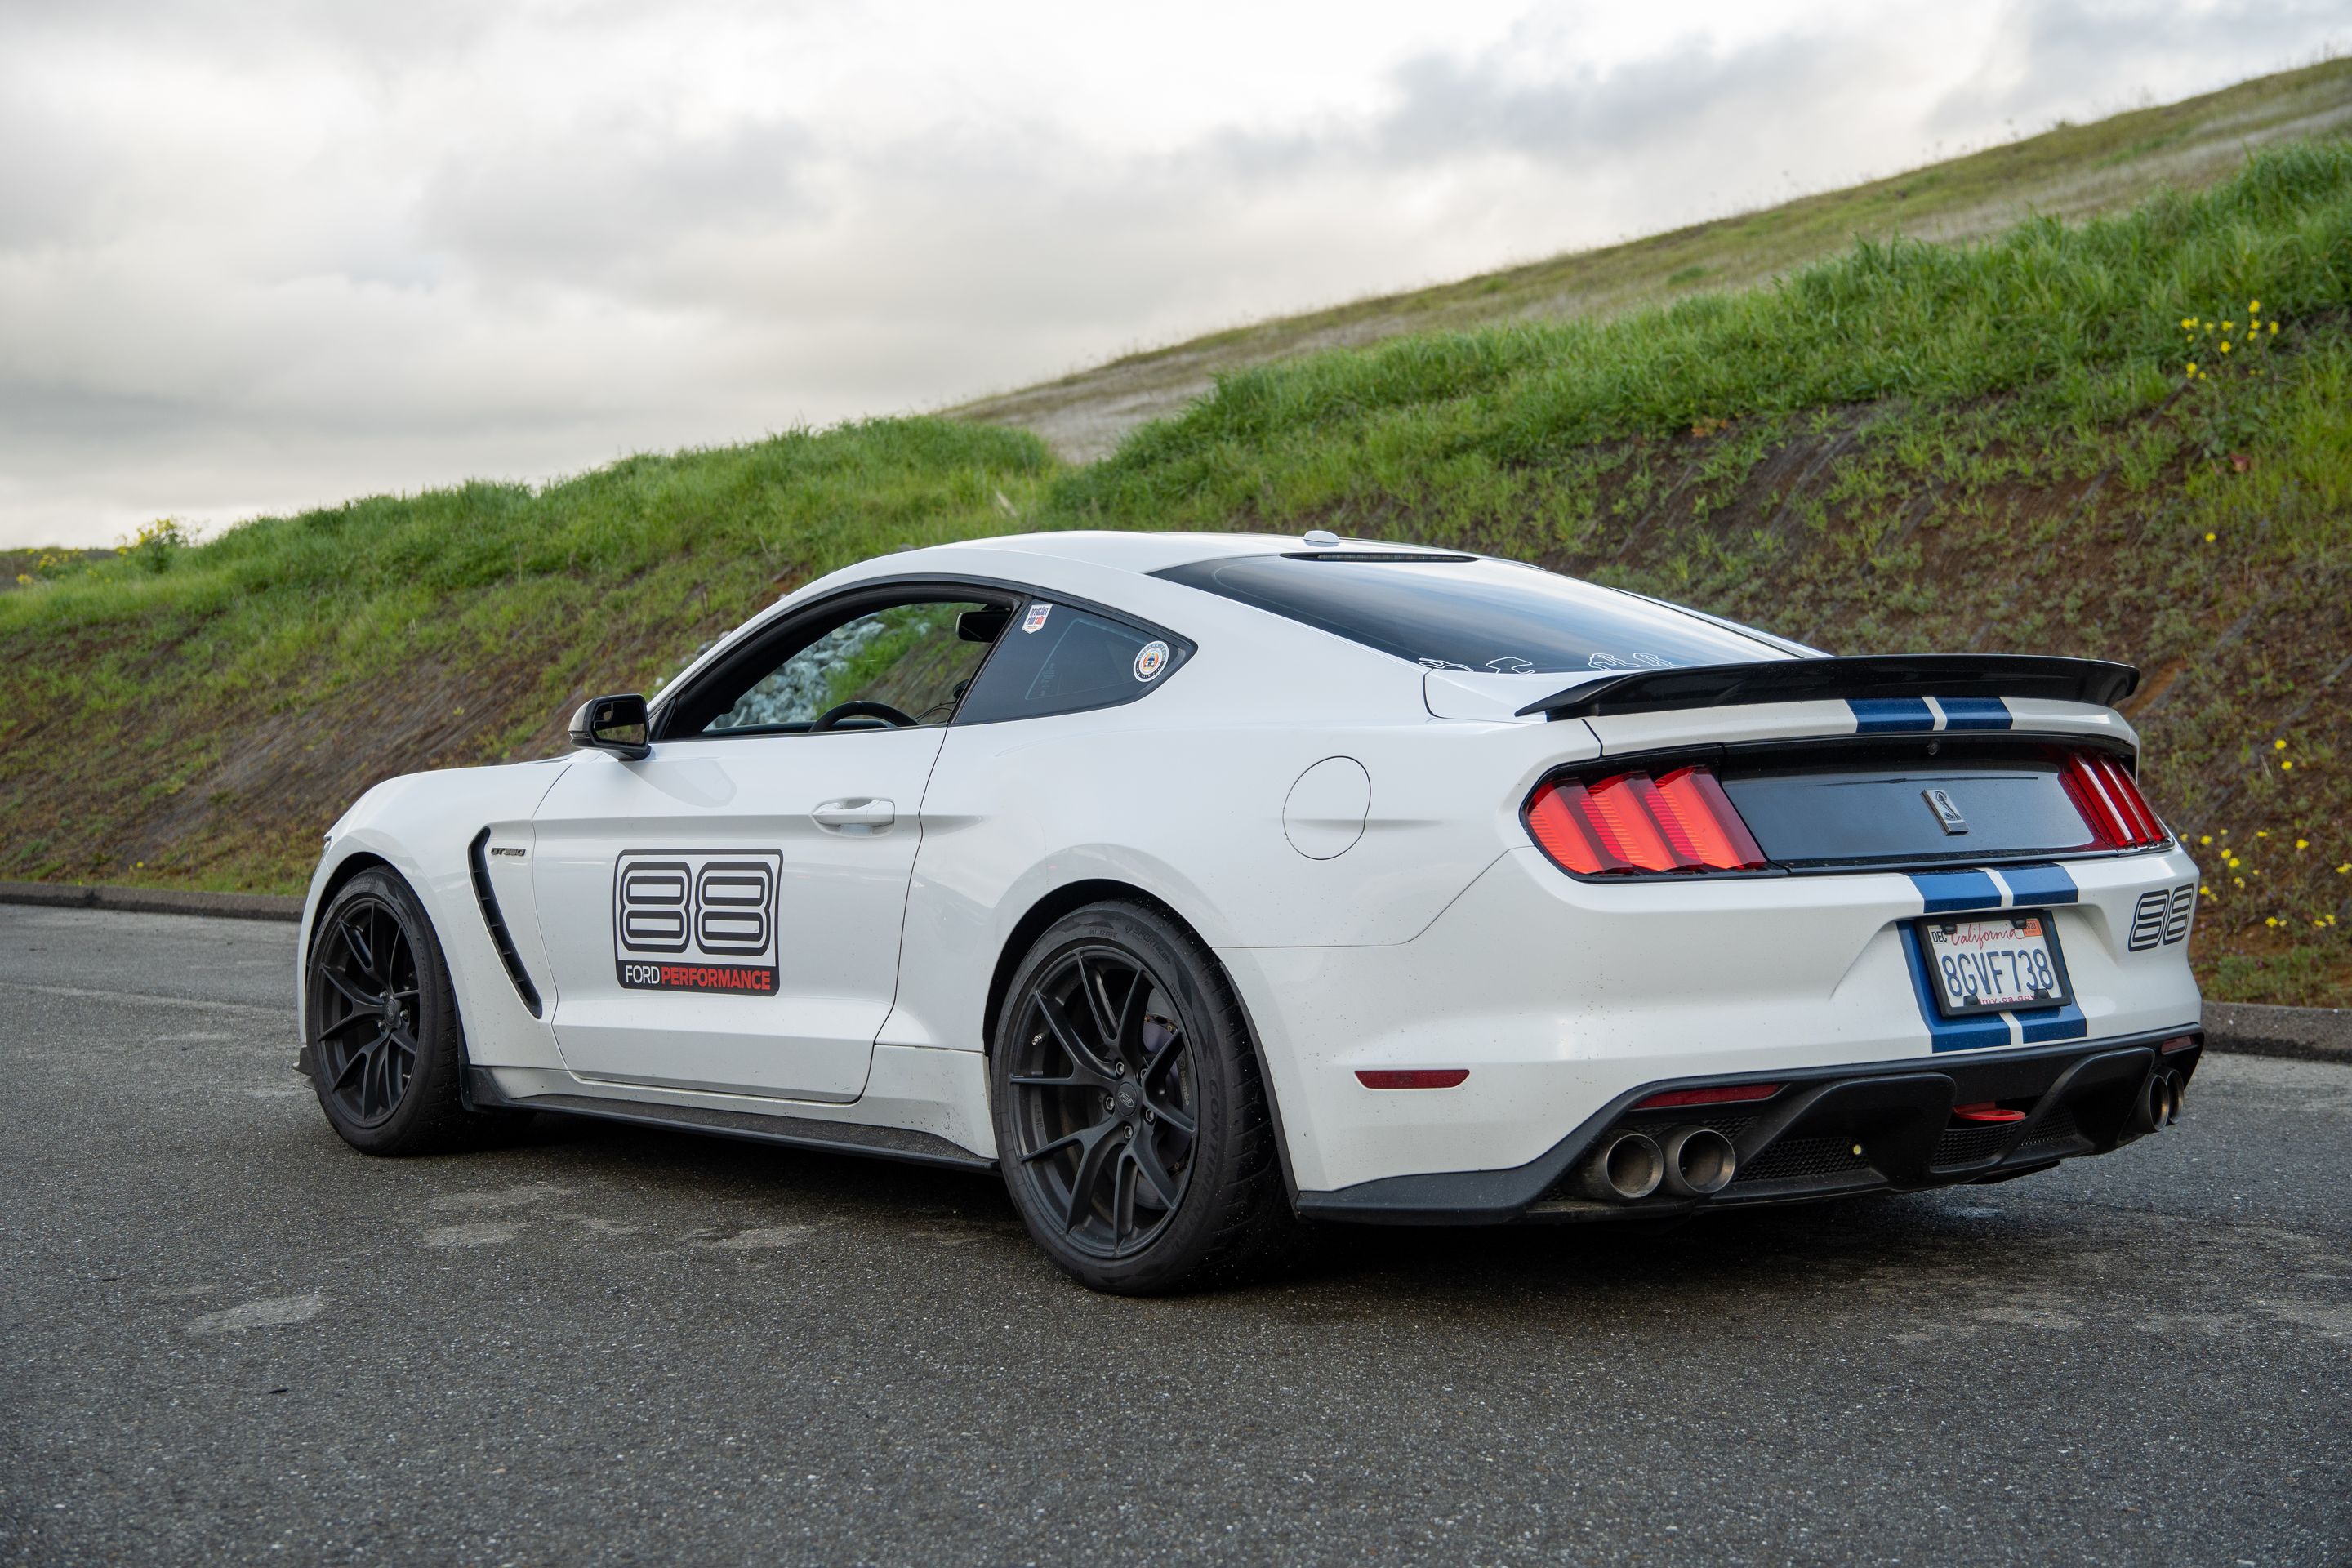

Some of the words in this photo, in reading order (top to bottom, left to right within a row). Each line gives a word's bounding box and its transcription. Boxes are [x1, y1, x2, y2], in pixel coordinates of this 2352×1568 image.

[620, 862, 773, 956] 88
[2128, 883, 2194, 952] 88
[1931, 931, 1948, 942] DEC
[1951, 923, 2025, 950] California
[626, 965, 661, 984] FORD
[662, 966, 771, 991] PERFORMANCE
[1941, 948, 2054, 997] 8GVF738
[1180, 1071, 1189, 1106] brembo
